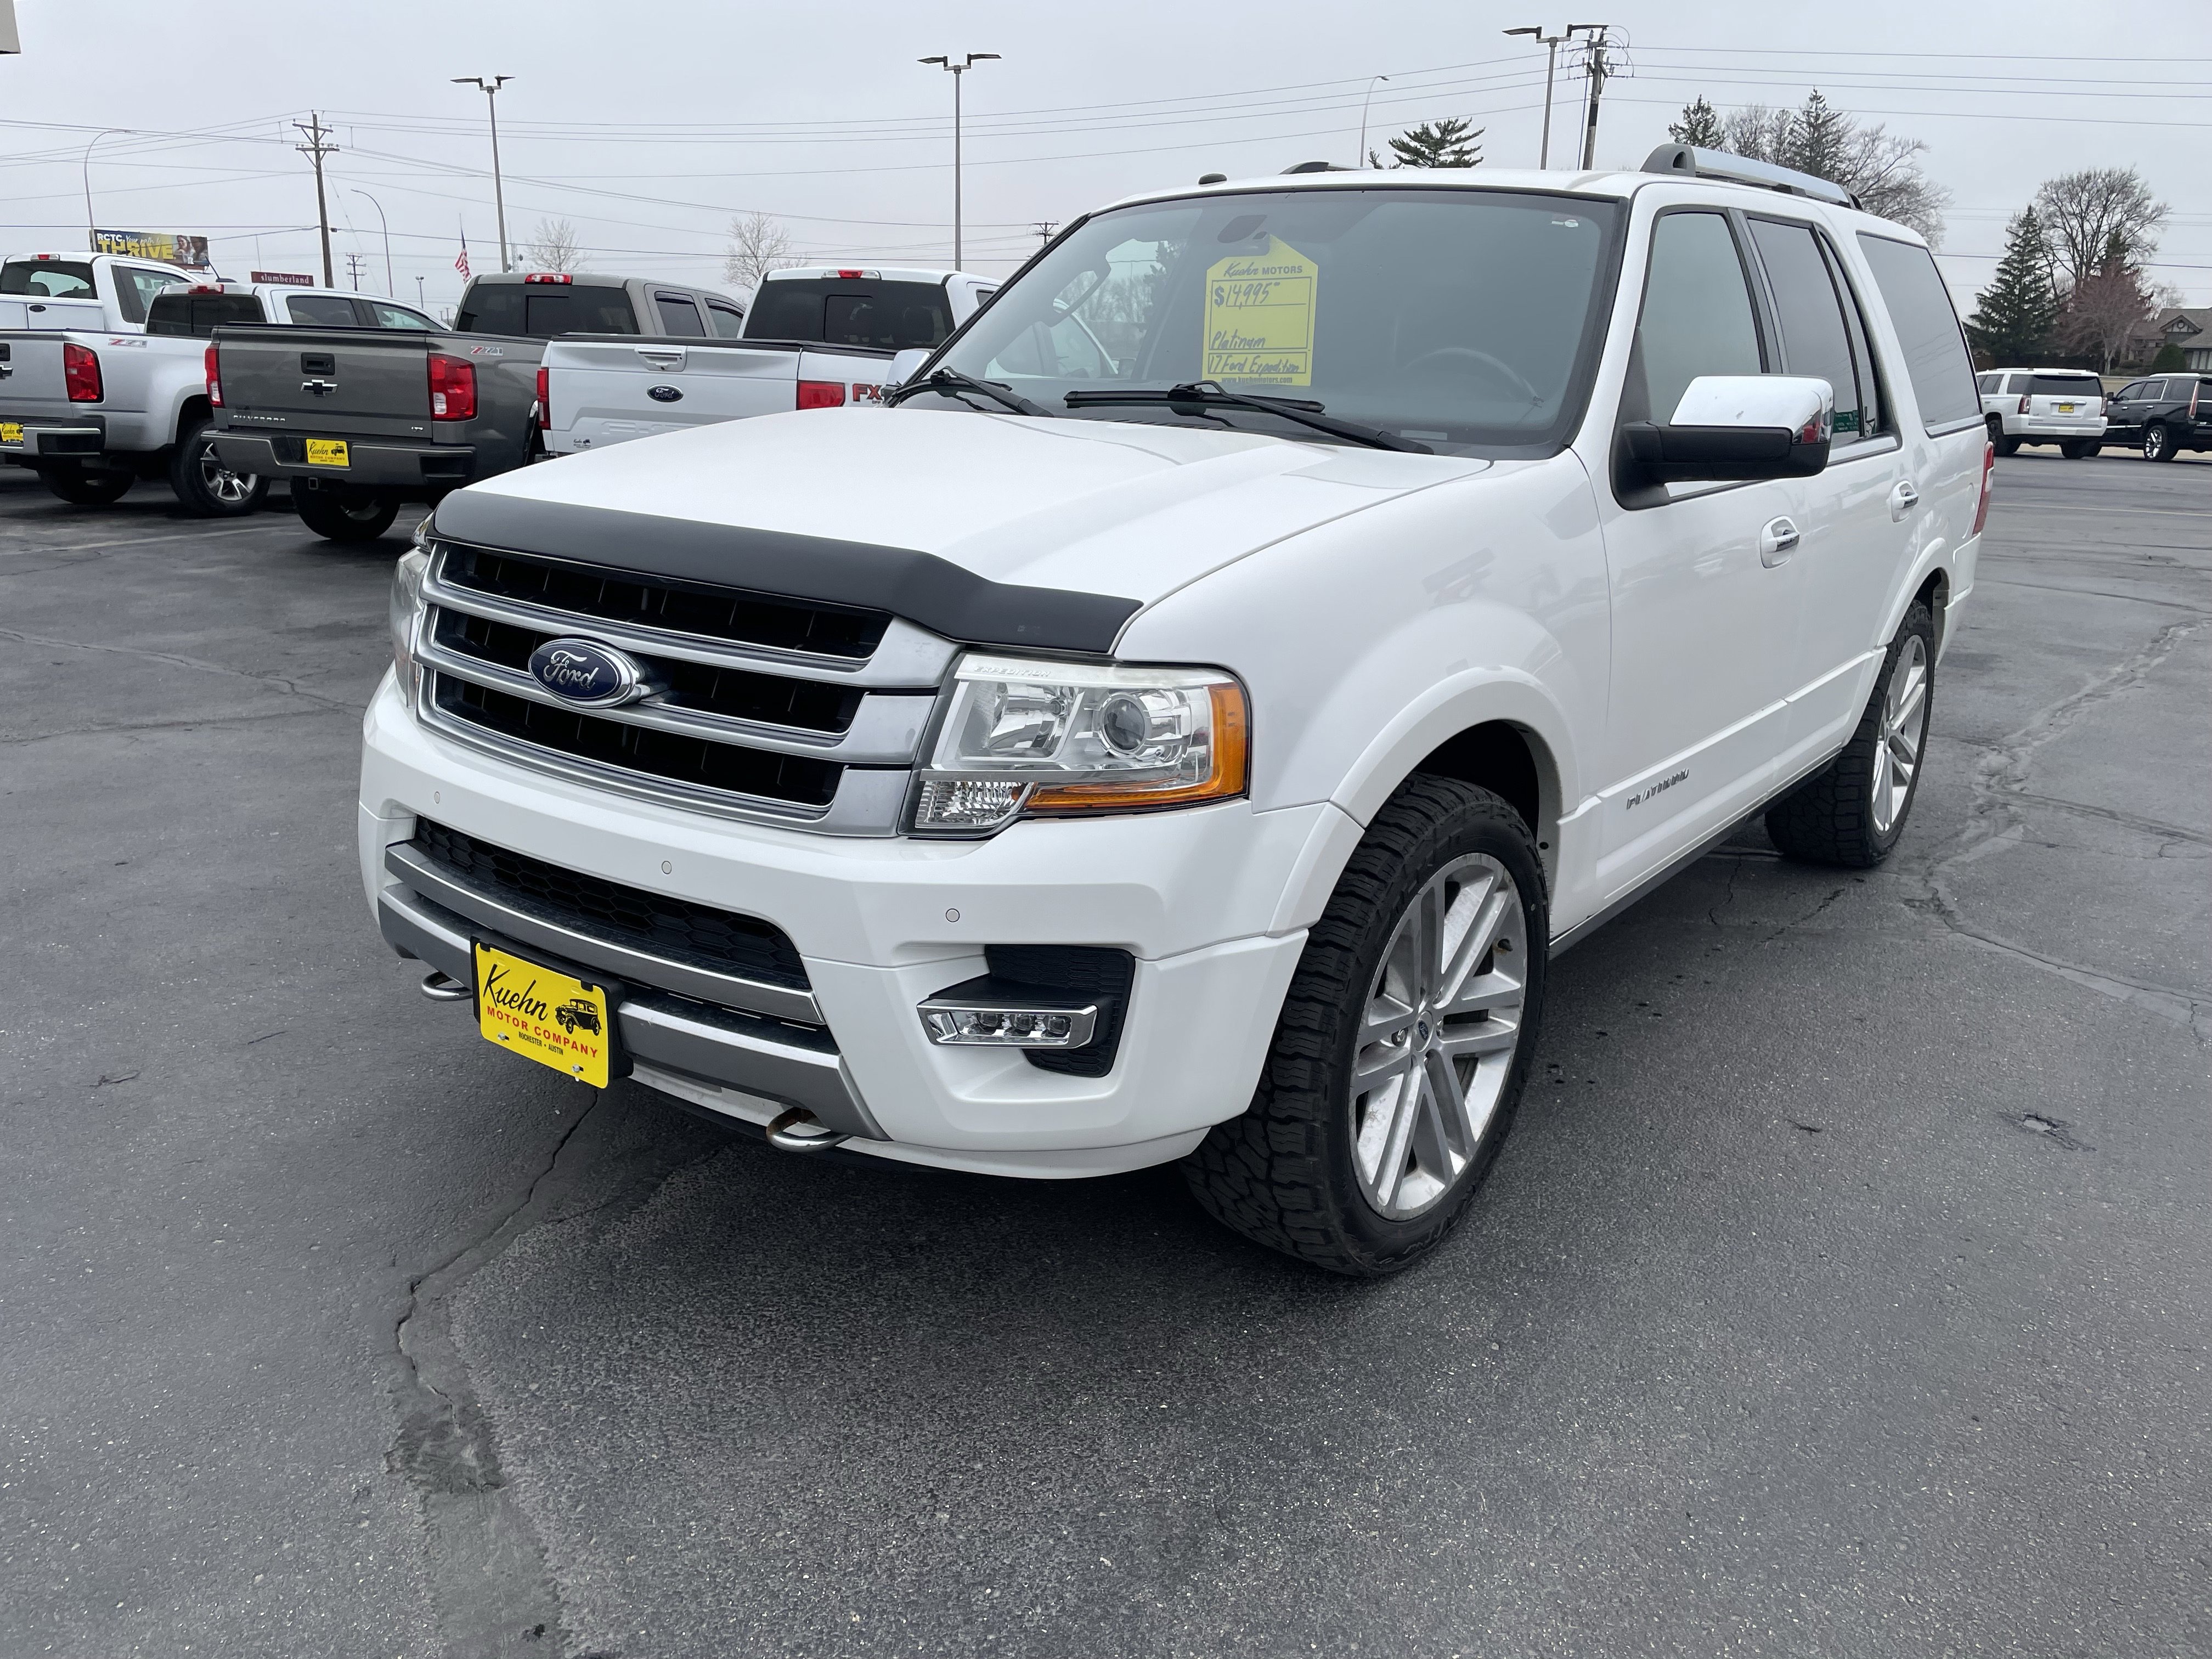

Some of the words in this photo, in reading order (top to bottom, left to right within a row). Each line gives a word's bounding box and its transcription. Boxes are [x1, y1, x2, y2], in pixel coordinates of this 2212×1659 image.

[97, 233, 125, 242] RCTC.
[1262, 266, 1303, 275] MOTORS
[261, 274, 309, 284] slumberland
[1211, 329, 1266, 349] Platinum
[470, 346, 503, 357] Z71
[1221, 355, 1248, 373] Ford
[654, 387, 674, 399] Ford
[853, 383, 883, 402] FX
[308, 441, 329, 456] Kuehn
[543, 650, 600, 691] Ford
[974, 667, 1051, 677] EXPEDITION
[1627, 768, 1689, 809] PLATINUM
[483, 963, 548, 1021] Kuehn
[487, 1005, 528, 1031] MOTOR
[534, 1025, 598, 1058] COMPANY
[518, 1031, 543, 1047] ROCHESTER
